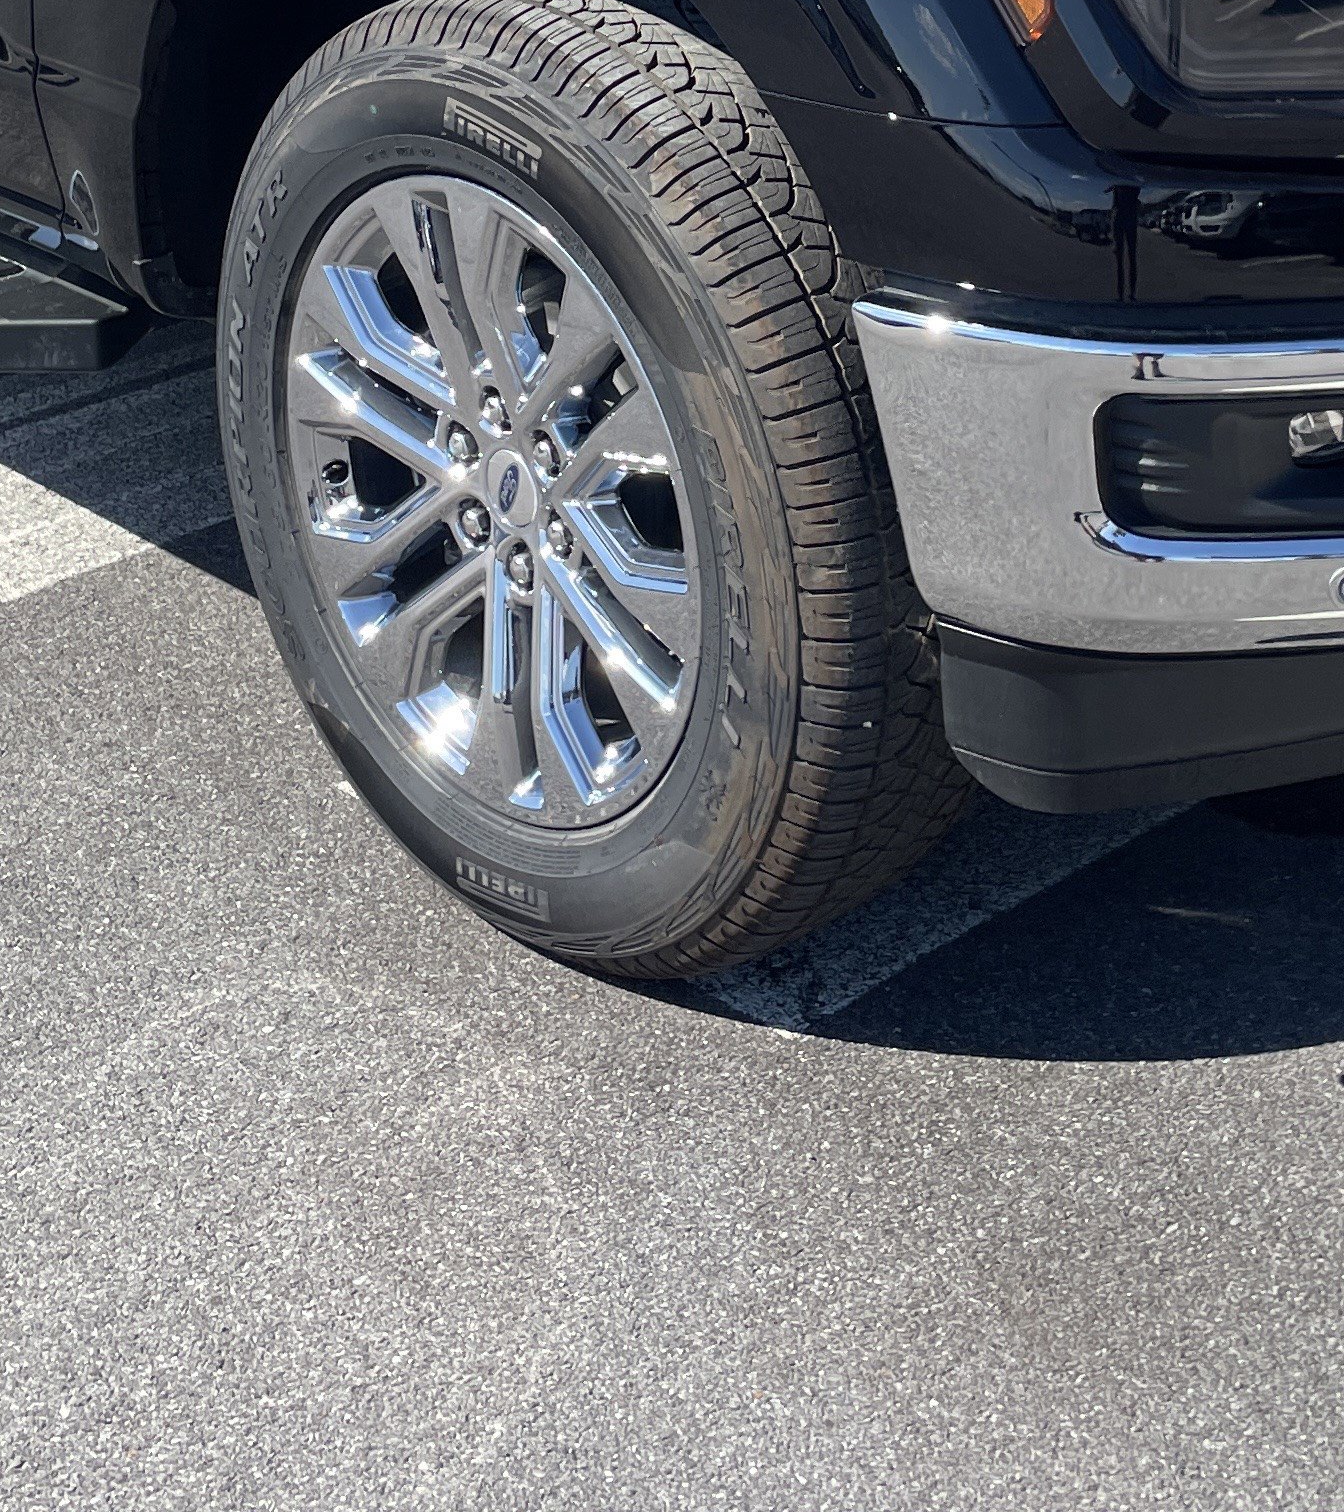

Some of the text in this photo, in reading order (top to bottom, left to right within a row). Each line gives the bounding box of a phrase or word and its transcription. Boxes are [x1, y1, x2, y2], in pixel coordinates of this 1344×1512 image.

[441, 97, 543, 181] PIRELLI
[243, 169, 289, 287] ATR
[690, 424, 753, 750] PIRELLI
[456, 856, 551, 923] PIRELLI
